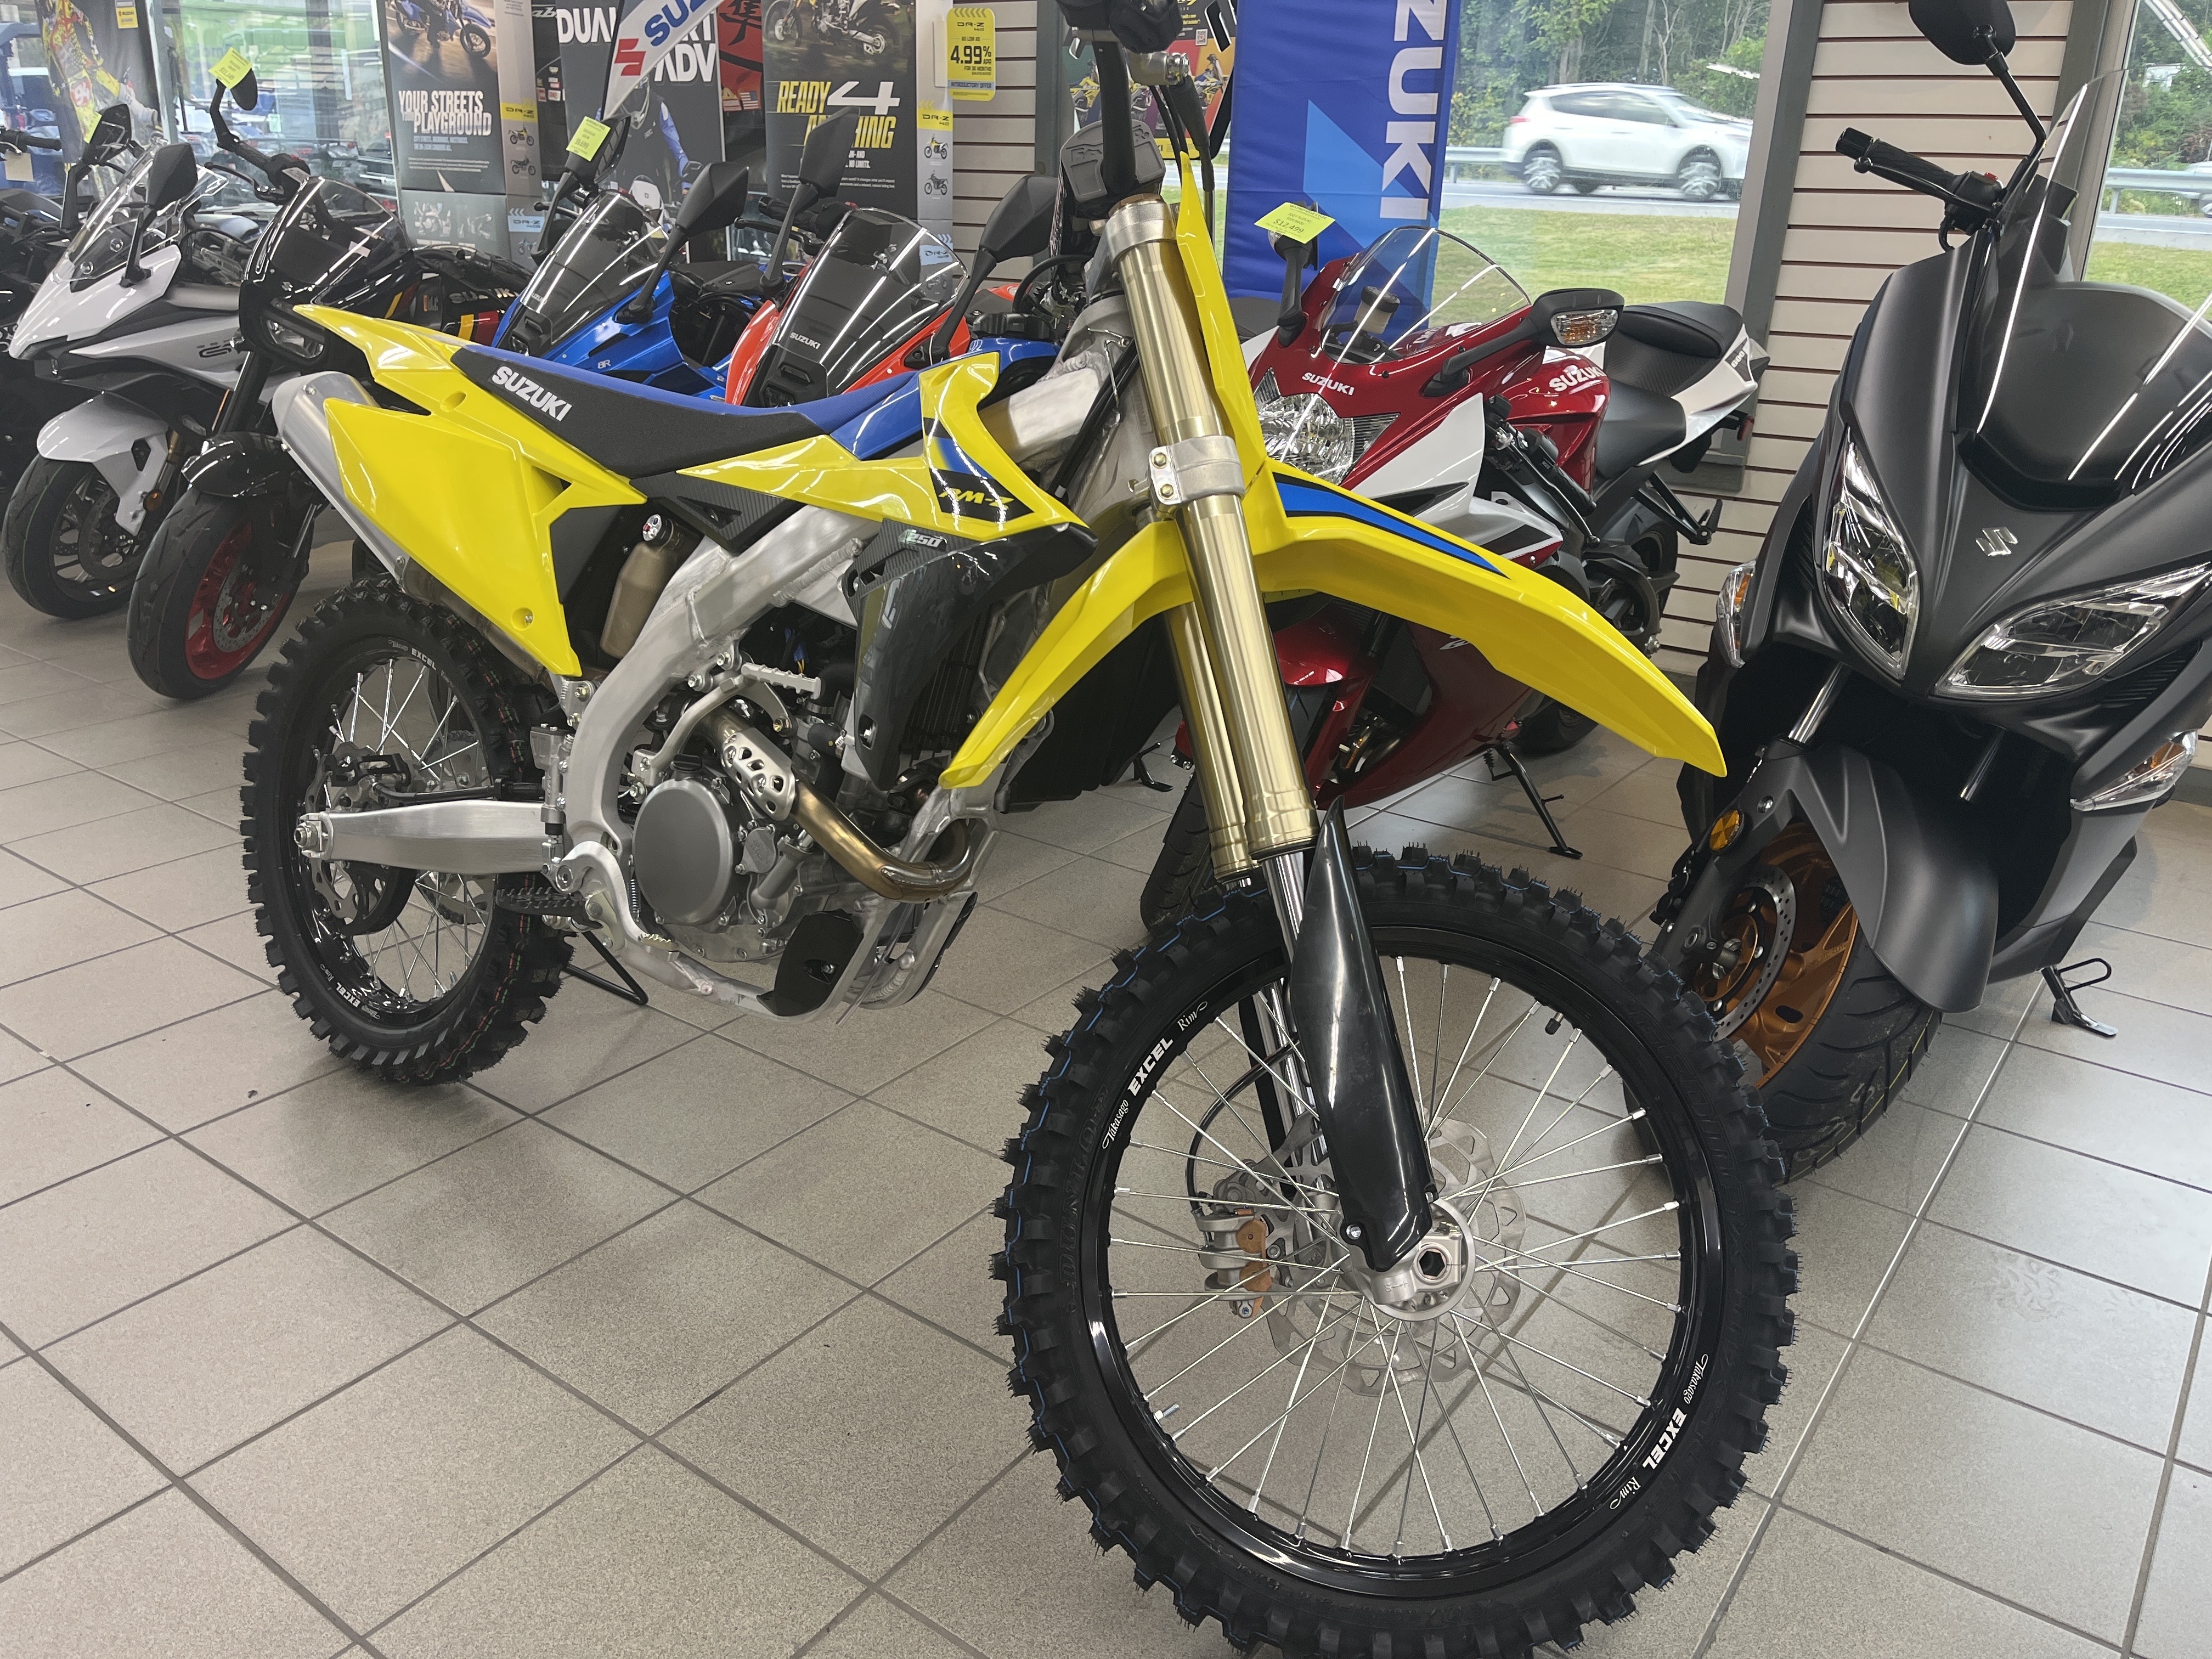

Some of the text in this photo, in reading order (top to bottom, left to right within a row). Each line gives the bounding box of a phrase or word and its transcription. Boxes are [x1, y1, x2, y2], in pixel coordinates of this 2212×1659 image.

[654, 43, 716, 82] ADV
[398, 90, 484, 114] YOUR STREETS
[777, 81, 901, 115] READY 4
[414, 111, 492, 136] PLAYGROUND
[1273, 219, 1305, 233] $12,499
[789, 332, 821, 349] SUZUKI
[597, 359, 611, 369] 8R
[1730, 351, 1745, 368] 600
[492, 366, 572, 421] SUZUKI
[1302, 372, 1355, 396] SUZUKI
[939, 488, 1014, 510] RM-Z
[906, 531, 943, 548] 250
[411, 647, 437, 671] EXCEL
[336, 982, 361, 1008] EXCEL
[1102, 1001, 1208, 1149] Takasago EXCEL Rim
[1610, 1353, 1708, 1509] Takasago EXCEL Rim
